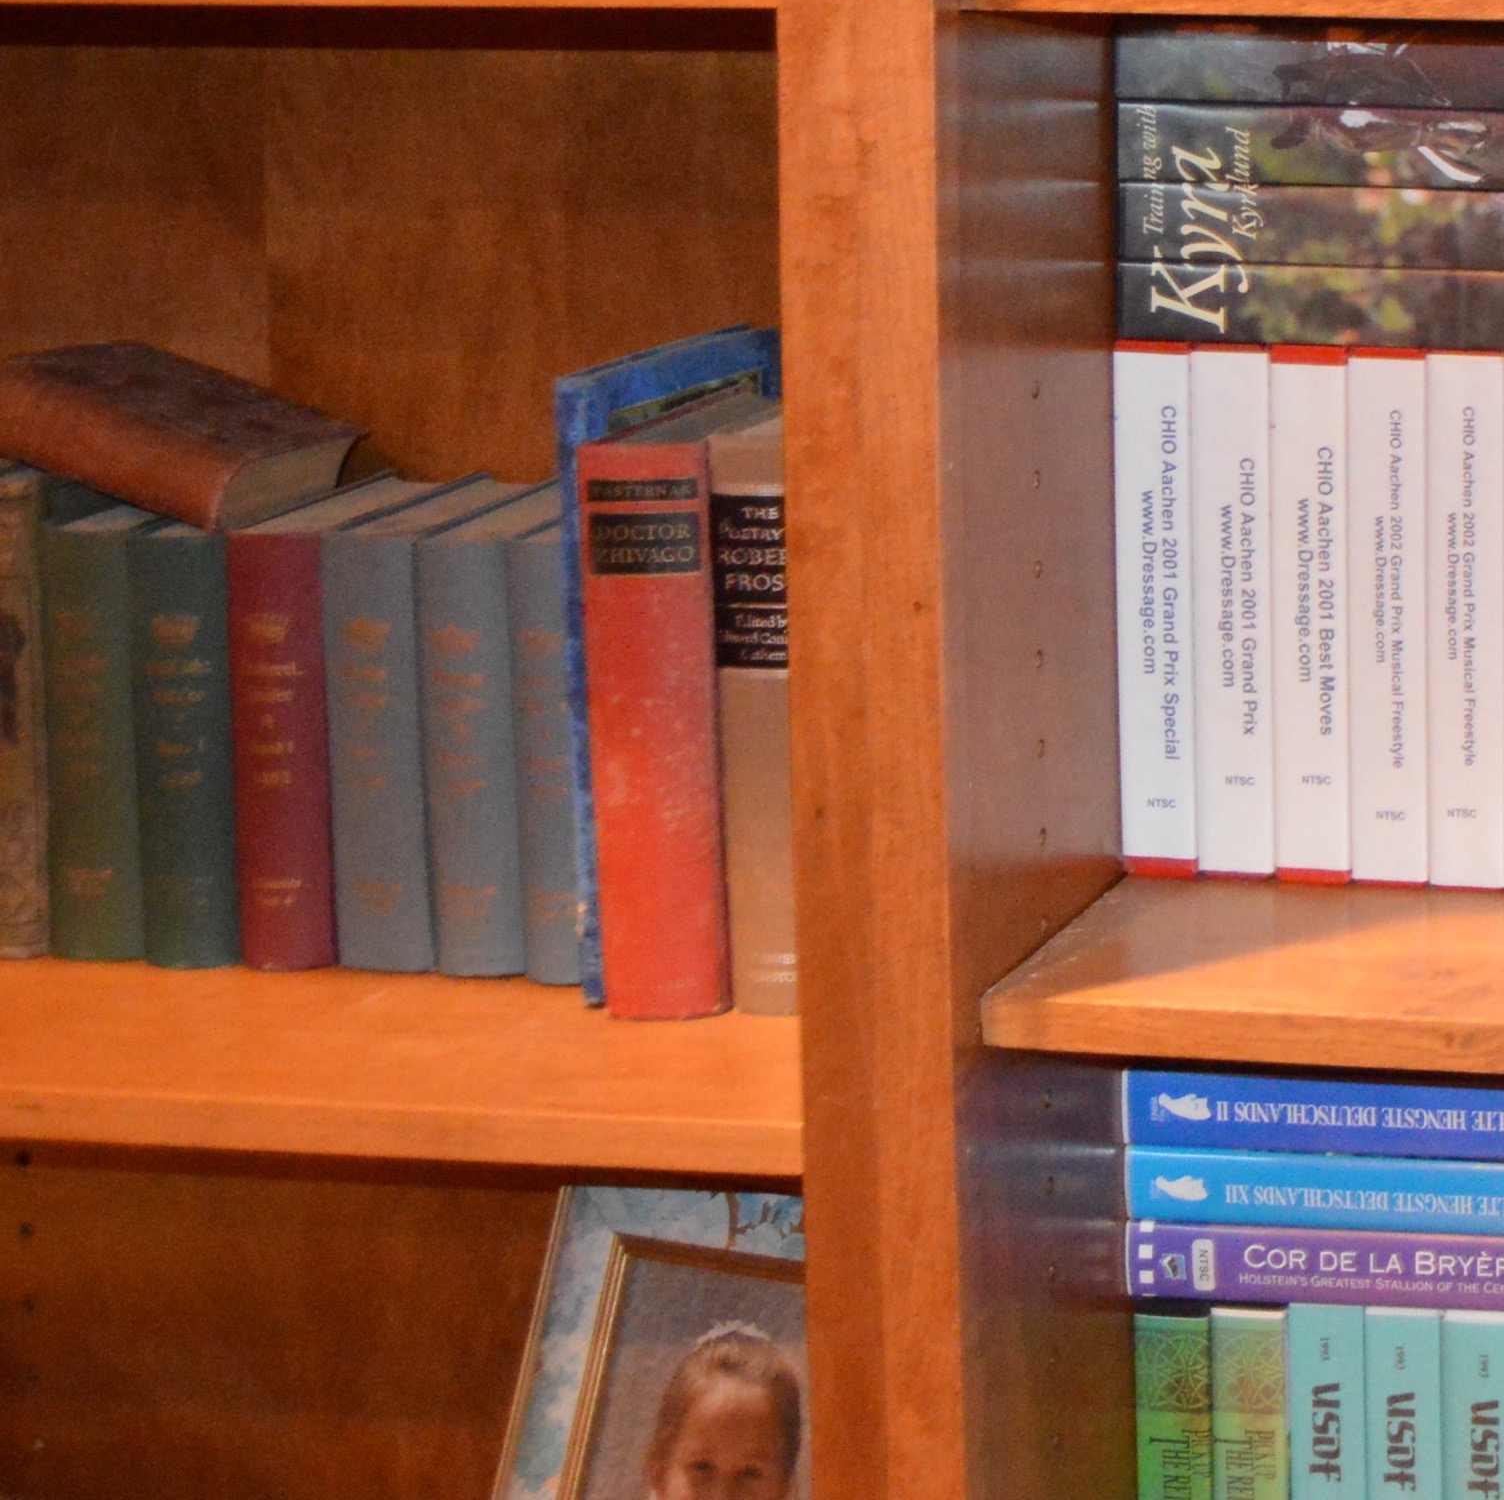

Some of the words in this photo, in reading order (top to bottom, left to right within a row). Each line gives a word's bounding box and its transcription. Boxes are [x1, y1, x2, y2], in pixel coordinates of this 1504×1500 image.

[1136, 103, 1156, 149] with
[1224, 126, 1264, 240] Kyrklund
[1149, 144, 1249, 334] Kyra
[1160, 404, 1178, 455] CHIO
[739, 505, 779, 520] THE
[1160, 459, 1178, 531] Aachen
[596, 522, 691, 542] DOCTOR
[597, 545, 695, 564] ZHIVAGO
[1161, 536, 1178, 579] 2001
[1140, 489, 1158, 675] www.Dressage.com
[1161, 586, 1179, 644] Grand
[1162, 649, 1179, 686] Prix
[1160, 692, 1180, 760] Special
[1146, 797, 1176, 809] NTSC
[1214, 1099, 1230, 1123] II
[1233, 1100, 1377, 1128] DEUTSCHLANDS
[1380, 1106, 1467, 1131] HENGSTE
[1197, 1248, 1210, 1282] NTSC
[1242, 1242, 1308, 1270] COR
[1318, 1249, 1358, 1273] DE
[1368, 1252, 1403, 1275] LA
